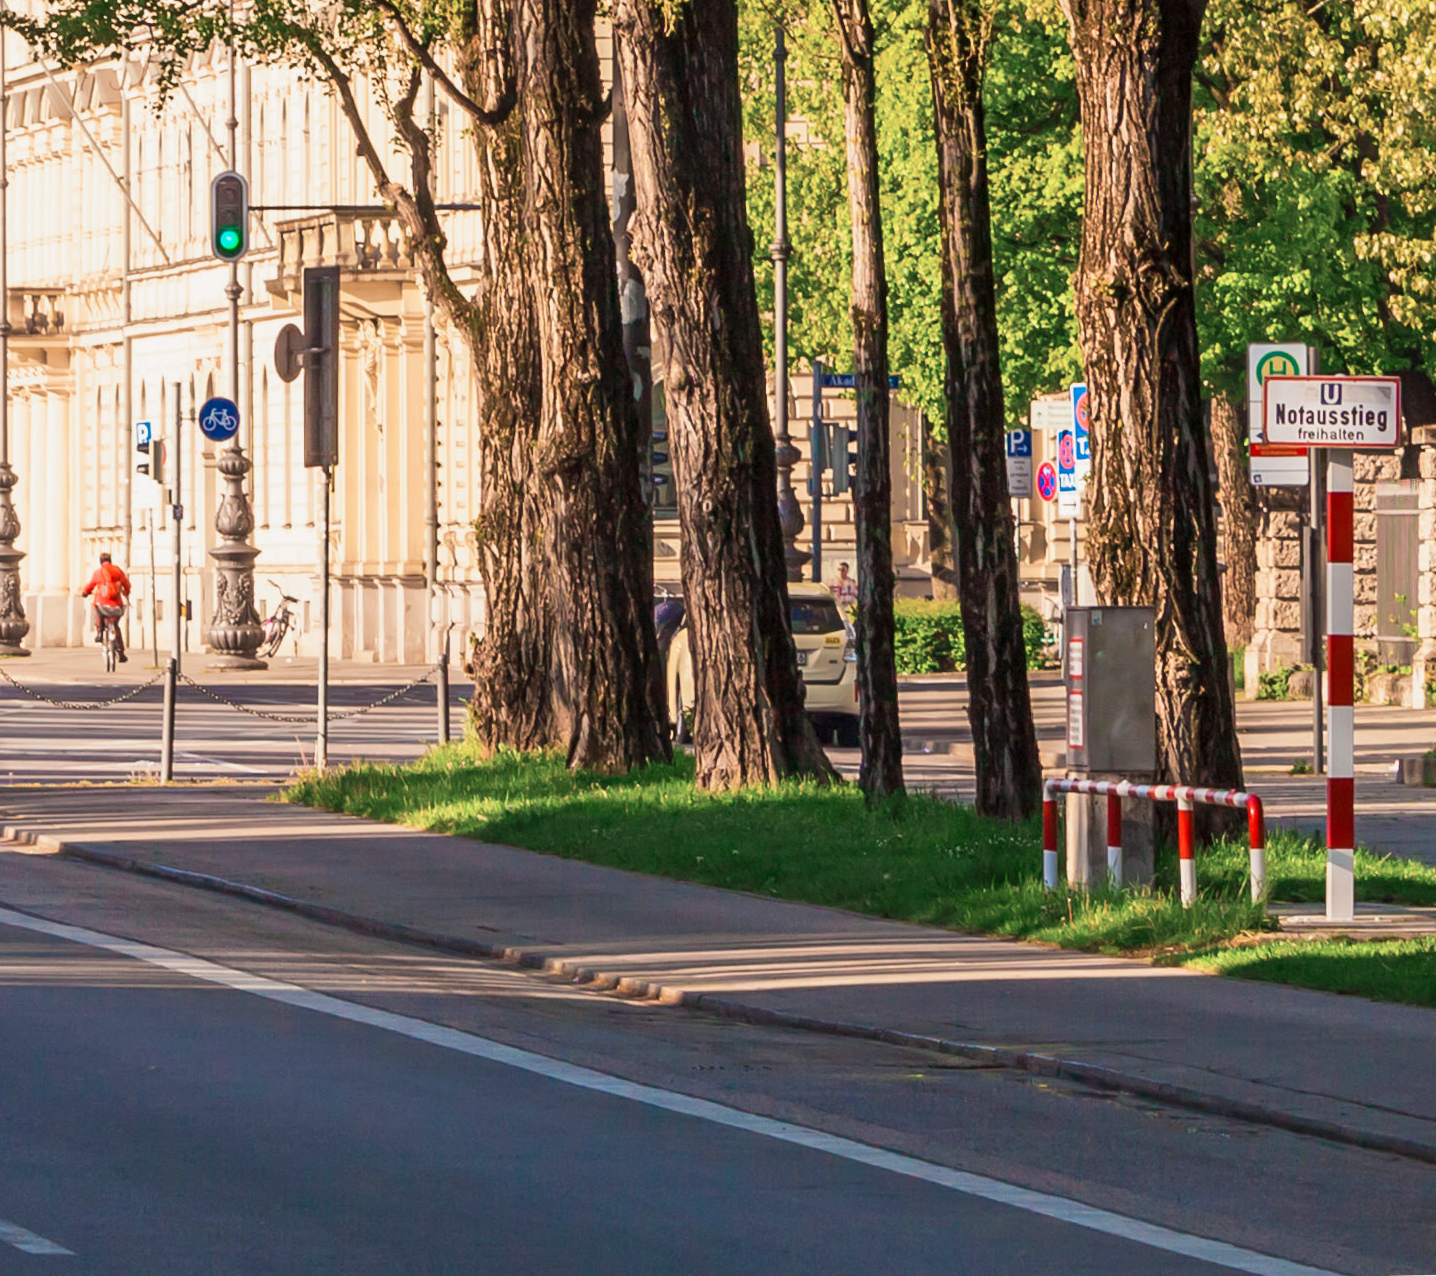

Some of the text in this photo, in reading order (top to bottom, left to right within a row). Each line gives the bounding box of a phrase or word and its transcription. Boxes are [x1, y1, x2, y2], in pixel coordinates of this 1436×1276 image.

[1323, 384, 1339, 405] U
[1276, 403, 1388, 432] Notausstieg
[1011, 429, 1025, 453] P
[1297, 427, 1365, 441] freihalten
